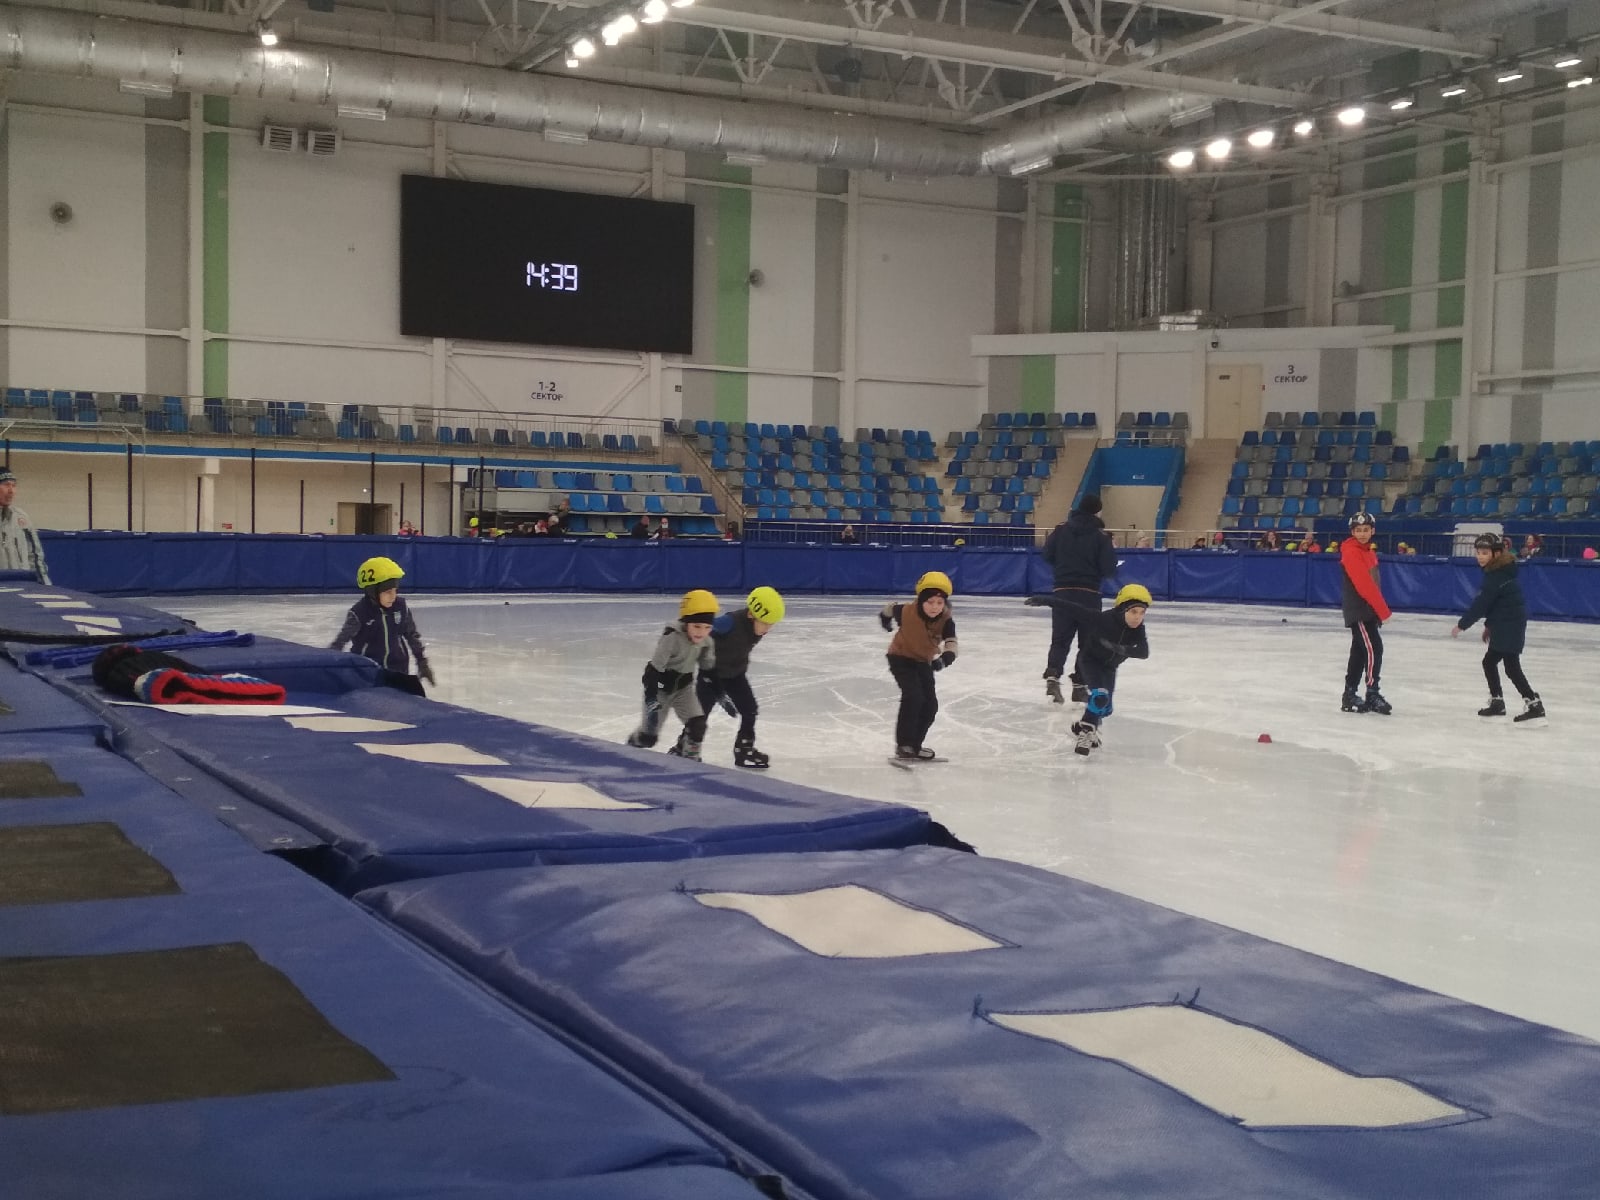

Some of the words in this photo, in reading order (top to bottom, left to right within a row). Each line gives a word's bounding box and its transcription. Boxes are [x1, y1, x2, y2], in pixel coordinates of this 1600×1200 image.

[526, 261, 578, 291] 14:39
[1287, 364, 1295, 375] 3
[1274, 375, 1308, 383] СЕКТОР
[538, 381, 556, 392] 1-2
[530, 392, 564, 401] СЕКТОР
[360, 568, 376, 583] 22
[749, 596, 770, 618] 107
